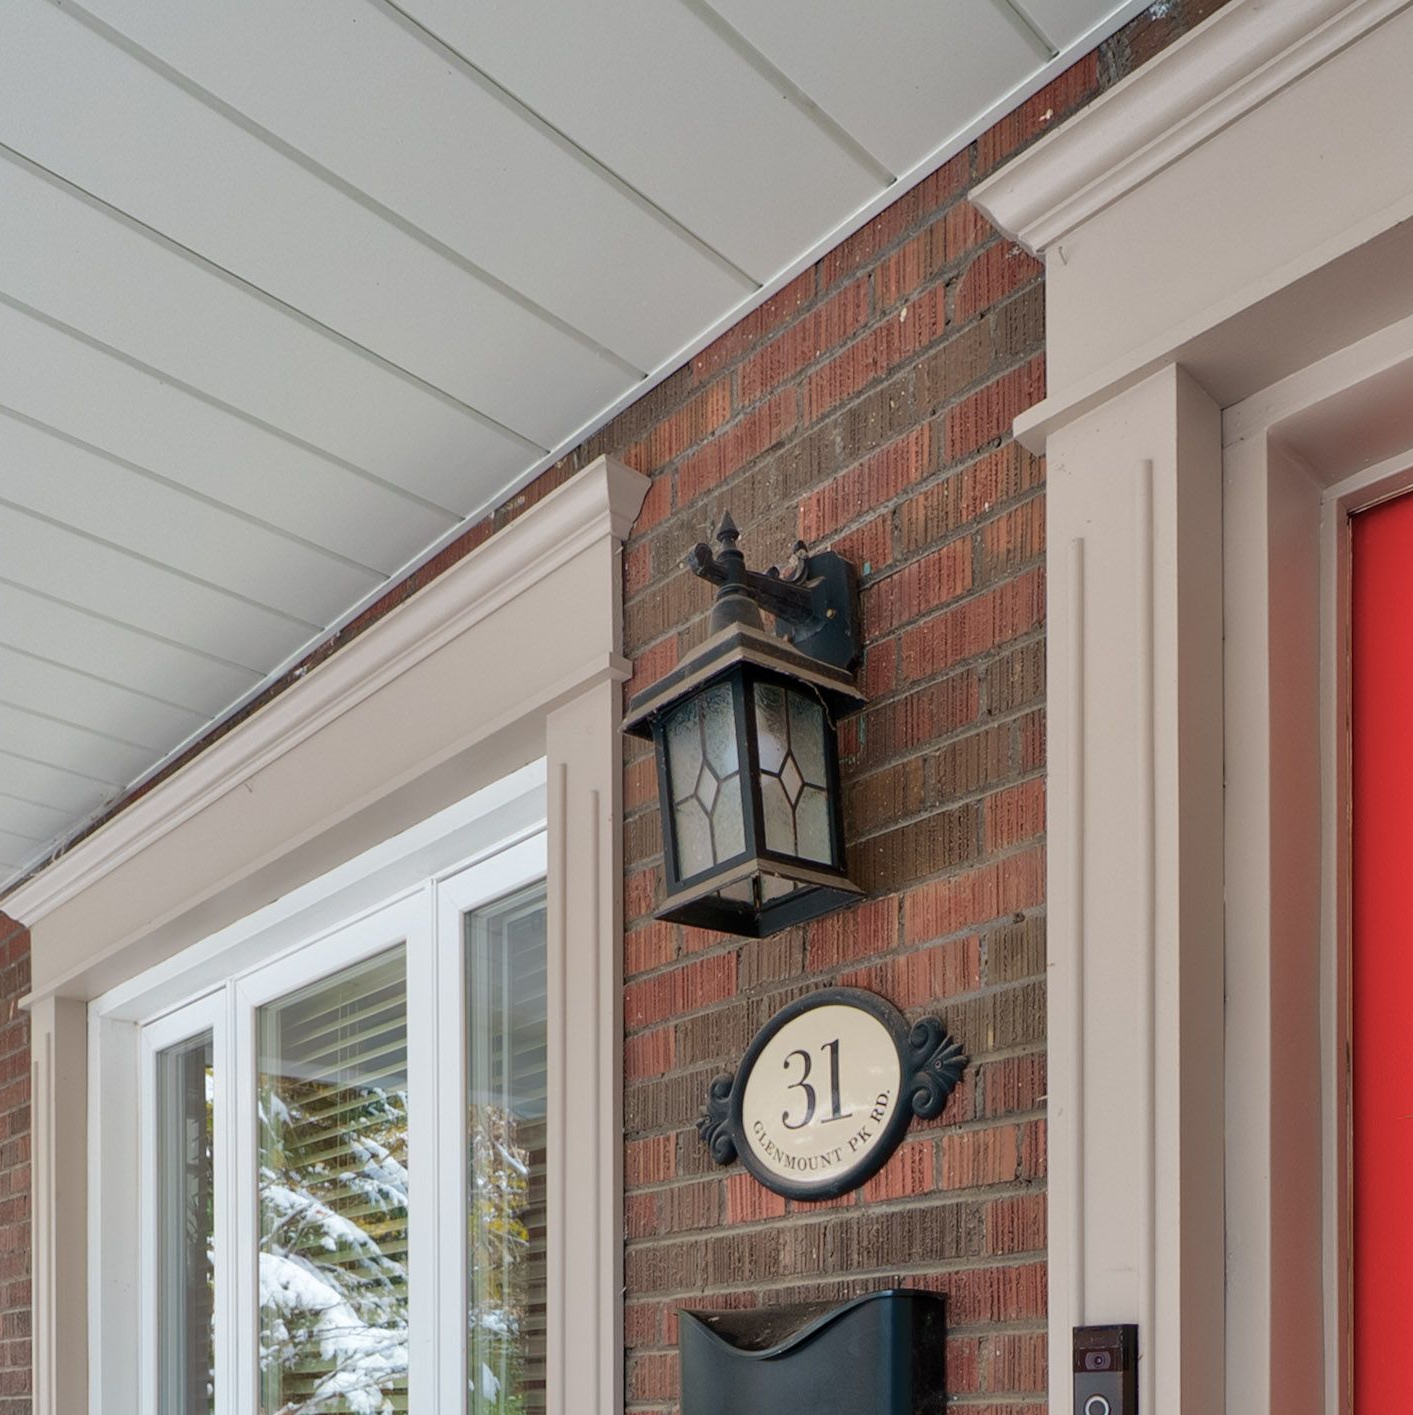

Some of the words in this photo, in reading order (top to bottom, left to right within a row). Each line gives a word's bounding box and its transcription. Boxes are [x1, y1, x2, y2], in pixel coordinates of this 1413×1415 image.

[782, 1038, 853, 1130] 31
[753, 1120, 842, 1171] GLENMOUNT
[847, 1125, 873, 1152] PK
[870, 1089, 891, 1124] RD.
